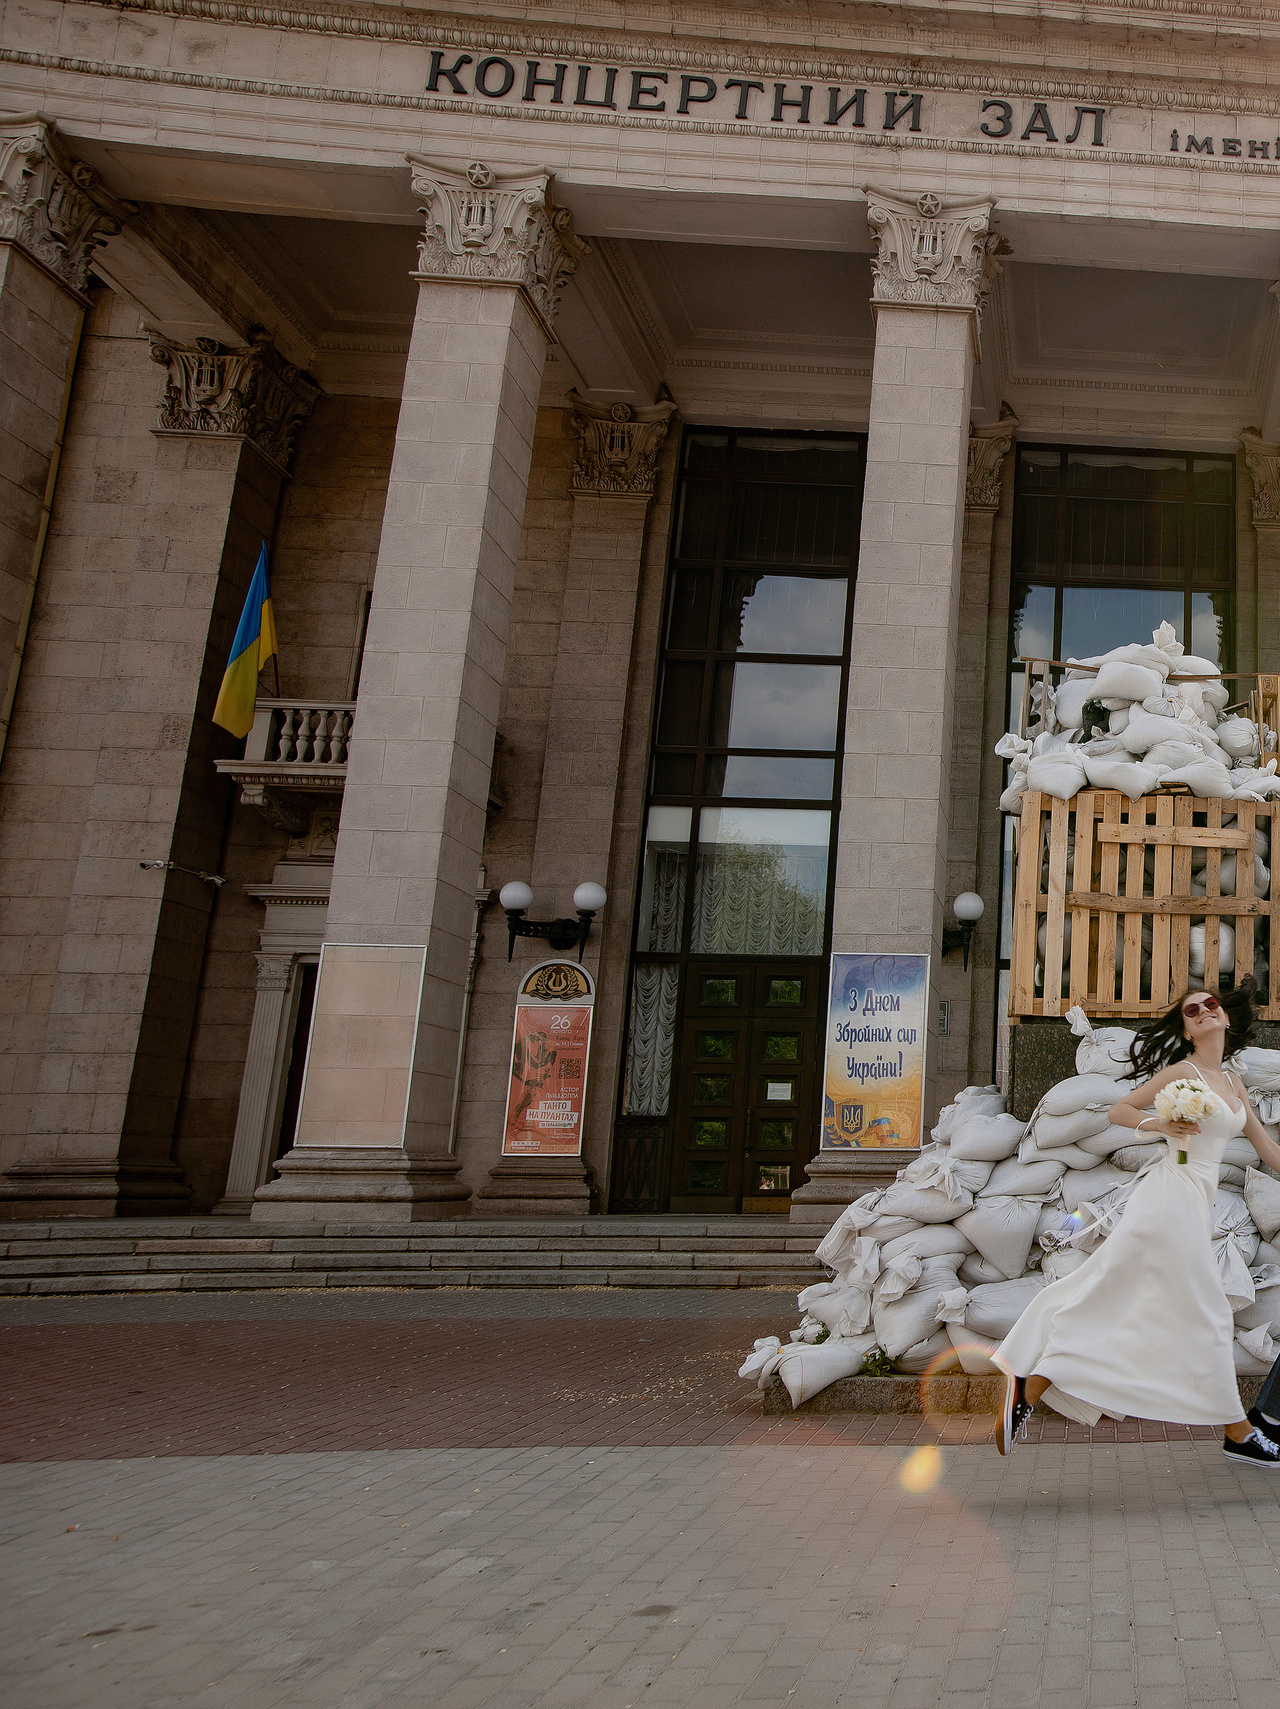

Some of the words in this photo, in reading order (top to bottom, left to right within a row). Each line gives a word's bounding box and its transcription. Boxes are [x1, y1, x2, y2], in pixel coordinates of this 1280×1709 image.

[426, 50, 922, 132] КОНЦЕРТНИЙ
[979, 100, 1106, 147] ЗАЛ
[848, 988, 858, 1012] З
[863, 988, 900, 1017] Днем
[550, 1014, 571, 1030] 26
[835, 1020, 892, 1049] Збройних
[897, 1027, 917, 1045] сил
[846, 1050, 904, 1085] України!
[528, 1110, 539, 1119] НА
[540, 1111, 575, 1122] ПУАНТАХ
[543, 1101, 567, 1110] ТАНГО
